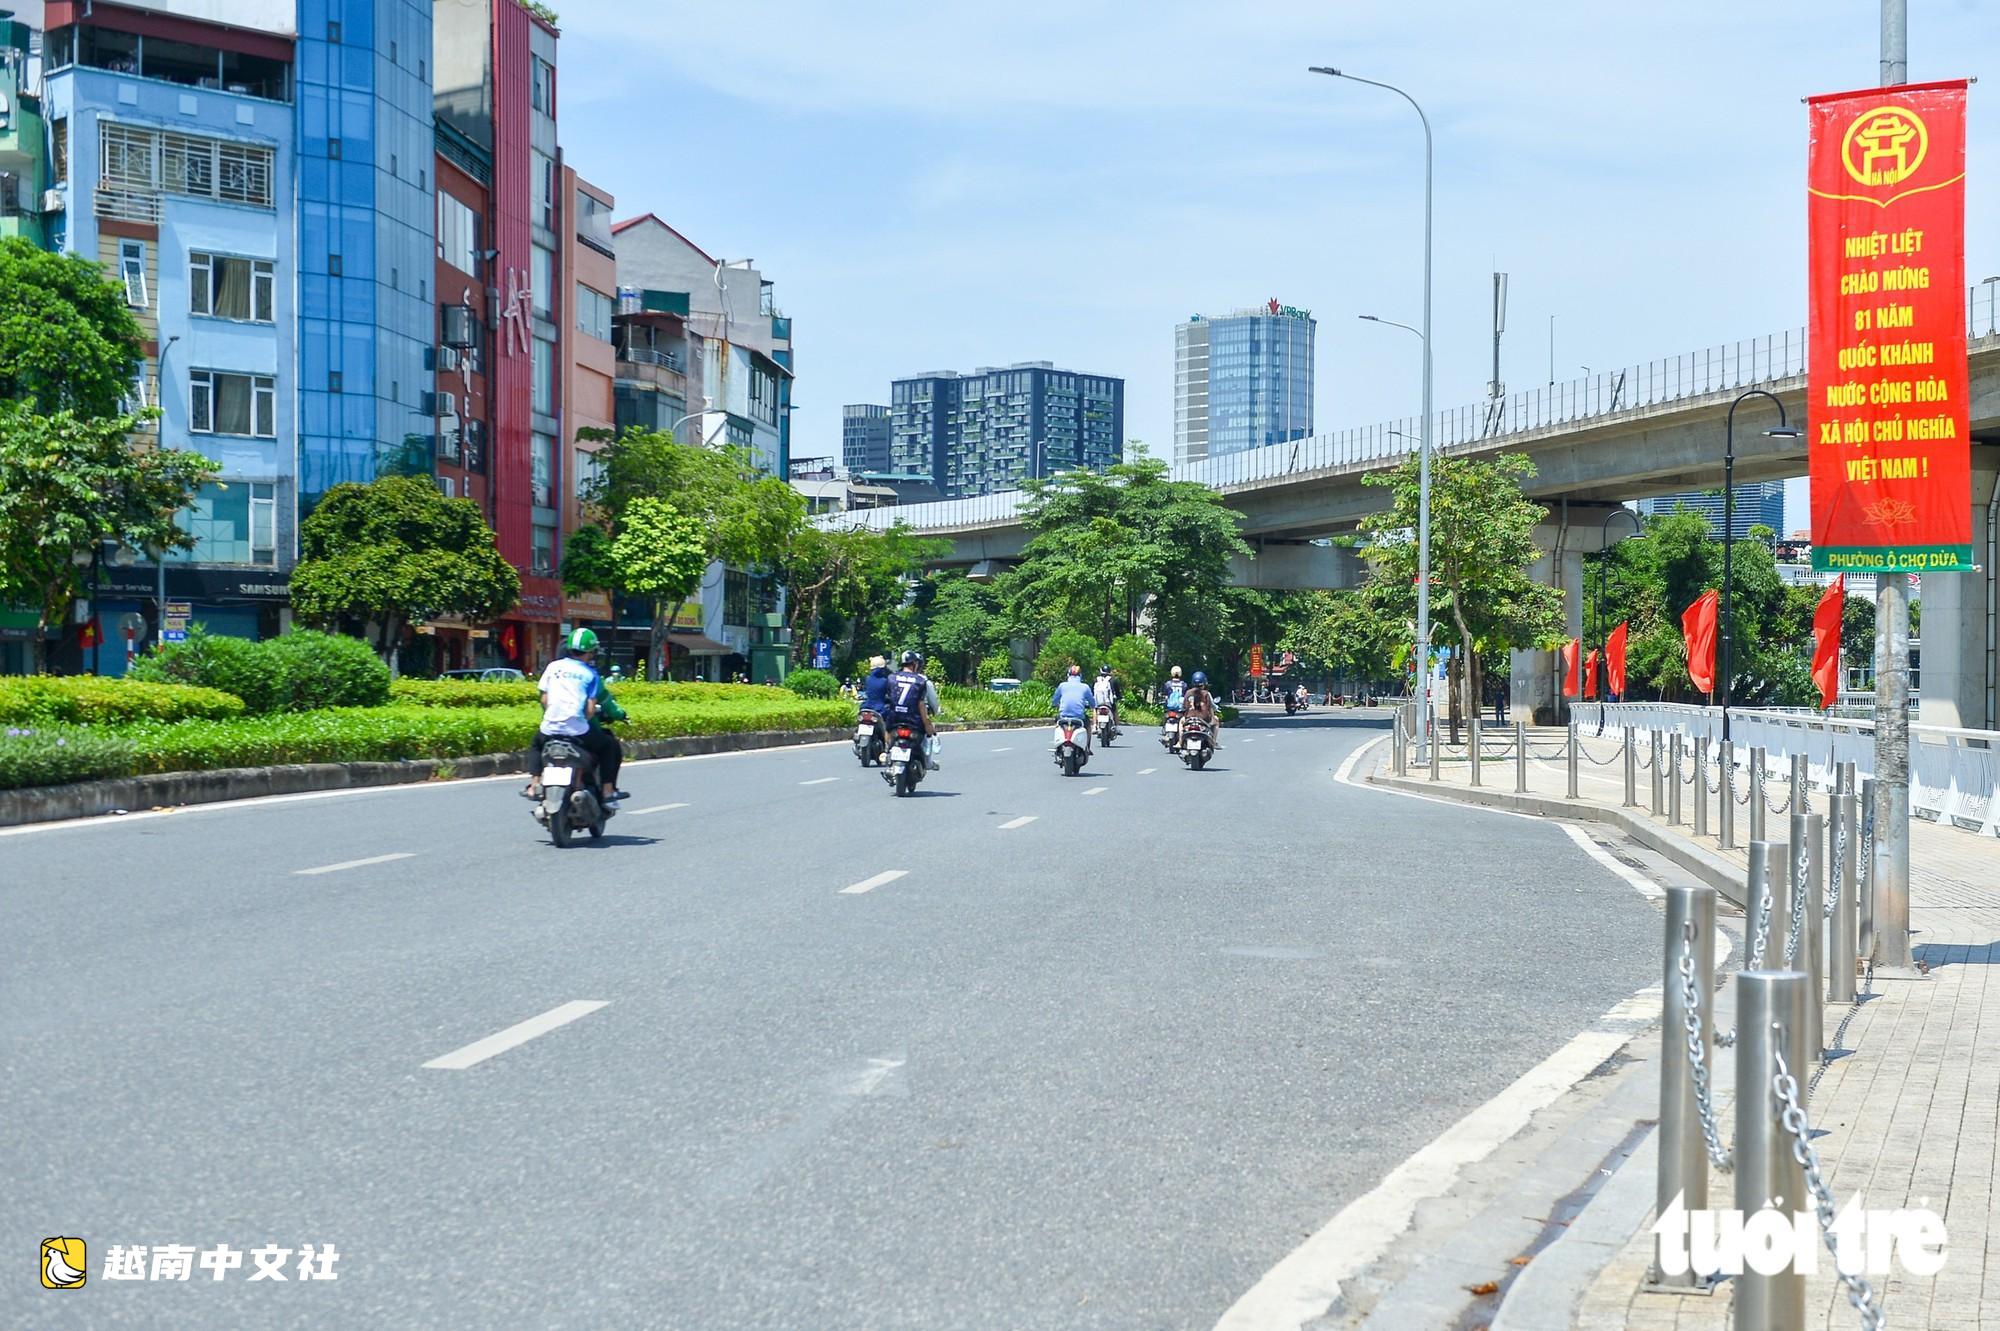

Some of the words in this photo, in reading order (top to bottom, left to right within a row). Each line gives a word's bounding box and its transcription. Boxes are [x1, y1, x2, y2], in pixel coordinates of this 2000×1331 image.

[1845, 230, 1888, 260] NHIỆT
[1891, 227, 1924, 257] LIỆT
[1840, 267, 1879, 296] CHÀO
[1882, 264, 1930, 292] MỪNG
[1280, 305, 1311, 320] VPBank
[1854, 309, 1871, 331] 81
[1876, 302, 1914, 329] NĂM
[1838, 339, 1877, 372] QUỐC
[1880, 340, 1934, 366] KHÁNH
[1826, 380, 1867, 408] NƯỚC
[1869, 378, 1912, 409] CỘNG
[1915, 374, 1948, 403] HÒA
[1820, 419, 1842, 445] XÃ
[1844, 417, 1870, 448] HỘI
[1873, 413, 1903, 442] CHỦ
[1906, 414, 1957, 441] NGHĨA
[1846, 455, 1878, 485] VIỆT
[1881, 457, 1918, 480] NAM
[1828, 551, 1884, 567] PHƯỜNG
[1899, 553, 1928, 570] CHỢ
[1929, 549, 1959, 567] DỪA
[87, 582, 123, 591] Cstomer
[125, 583, 153, 592] Service
[239, 583, 292, 596] SAMSUN
[820, 642, 827, 652] P
[897, 682, 912, 706] 7
